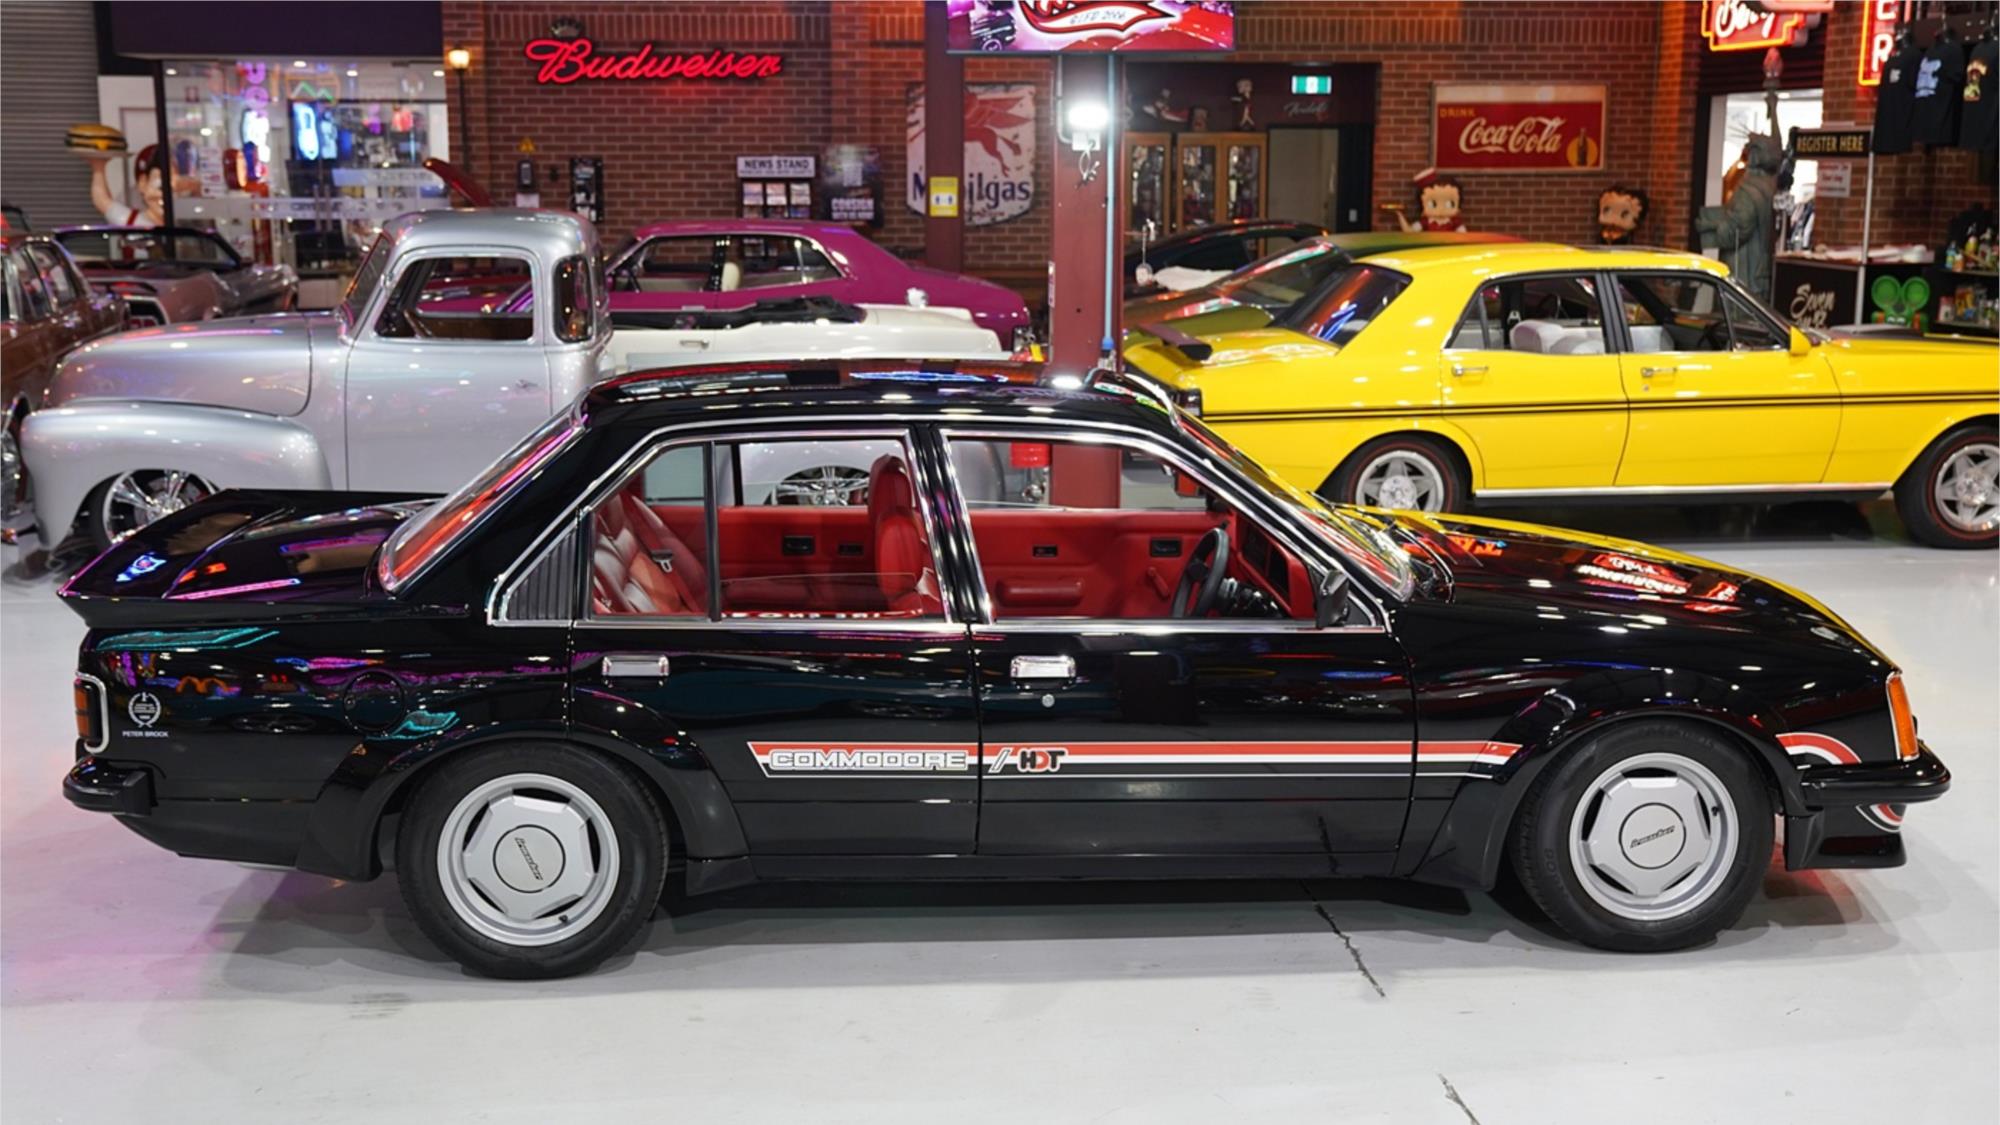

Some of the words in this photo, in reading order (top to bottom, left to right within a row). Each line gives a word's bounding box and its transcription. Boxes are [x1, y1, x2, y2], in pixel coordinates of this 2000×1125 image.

[525, 39, 782, 83] Budweiser
[1439, 108, 1475, 118] DRINK
[1458, 115, 1567, 154] Coca-Cola
[1796, 135, 1838, 152] REGISTER
[1839, 135, 1864, 152] HERE
[744, 159, 773, 170] NEWS
[775, 159, 810, 169] STAND
[913, 172, 1031, 210] Milgas
[770, 750, 968, 771] COMMODORE
